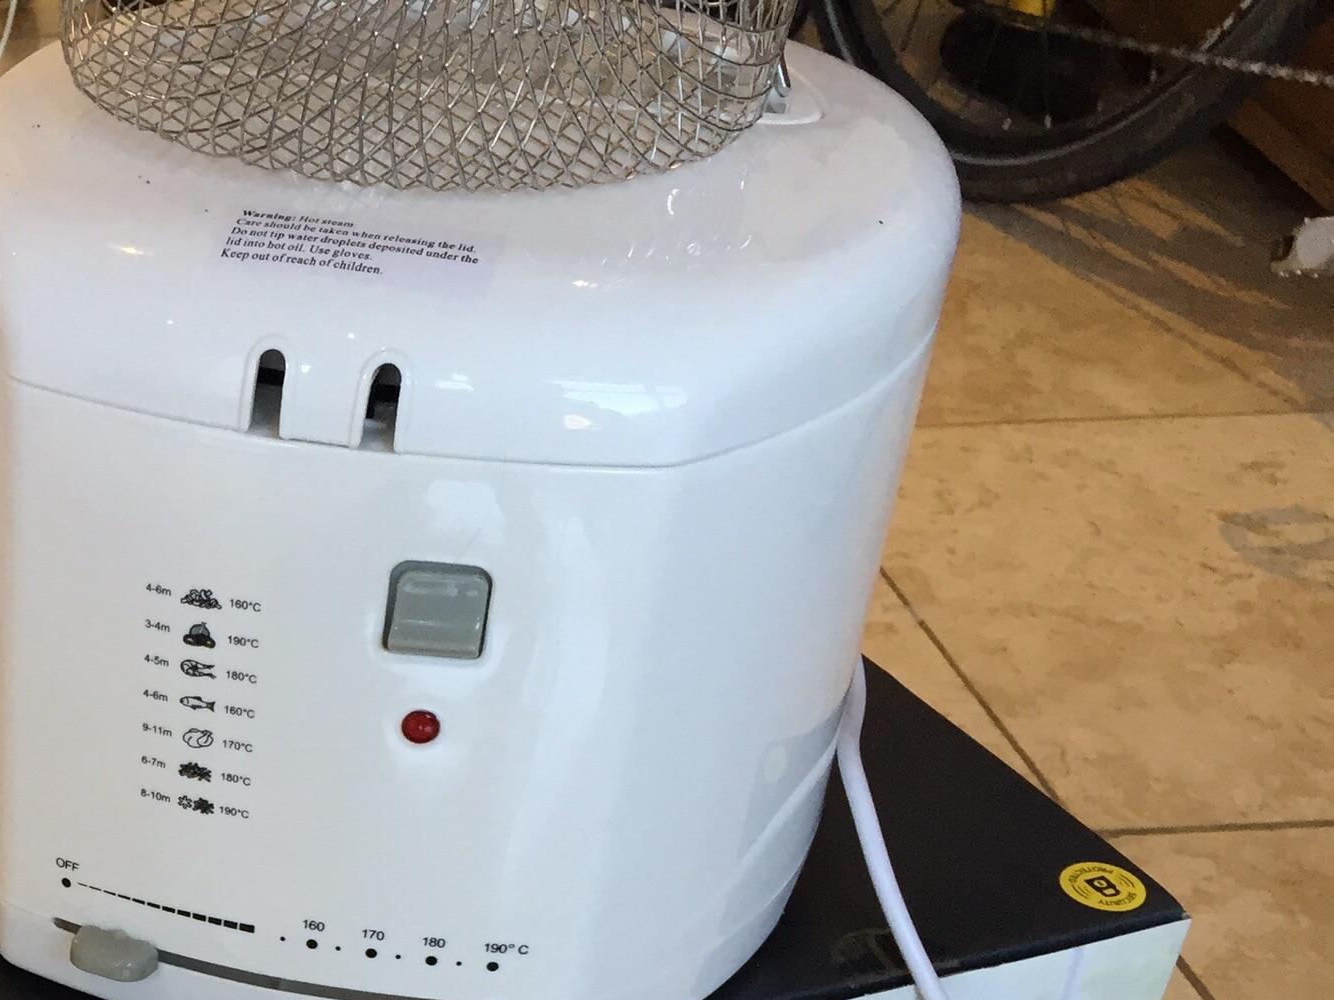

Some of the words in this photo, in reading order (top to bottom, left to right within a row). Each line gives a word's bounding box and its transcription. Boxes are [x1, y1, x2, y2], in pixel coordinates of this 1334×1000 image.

[243, 210, 296, 222] Warning:
[236, 218, 262, 227] Care
[264, 221, 301, 231] should
[303, 224, 317, 233] be
[318, 227, 349, 237] taken
[352, 231, 382, 241] when
[383, 235, 436, 249] releasing
[437, 241, 456, 250] the
[226, 237, 242, 247] lid
[243, 239, 266, 249] into
[309, 245, 331, 255] Use
[331, 248, 373, 261] gloves.
[231, 226, 248, 236] Do
[249, 229, 268, 238] not
[270, 230, 285, 241] tip
[287, 233, 319, 243] water
[320, 236, 366, 248] droplets
[368, 242, 424, 256] deposited
[426, 250, 459, 261] under
[460, 255, 480, 265] the
[221, 248, 250, 262] Keep
[251, 252, 271, 261] out
[272, 253, 288, 263] of
[286, 256, 317, 267] reach
[318, 258, 335, 268] of
[333, 260, 384, 276] children.
[146, 583, 172, 597] 4-6m
[145, 619, 171, 633] 3-4m
[144, 654, 170, 668] 4-5m
[142, 688, 169, 703] 4-6m
[142, 723, 173, 738] 9-11m
[141, 755, 166, 769] 6-7m
[140, 788, 171, 803] 8-10m
[55, 856, 80, 873] OFF
[302, 919, 326, 932] 160
[361, 929, 385, 941] 170
[421, 937, 446, 949] 180
